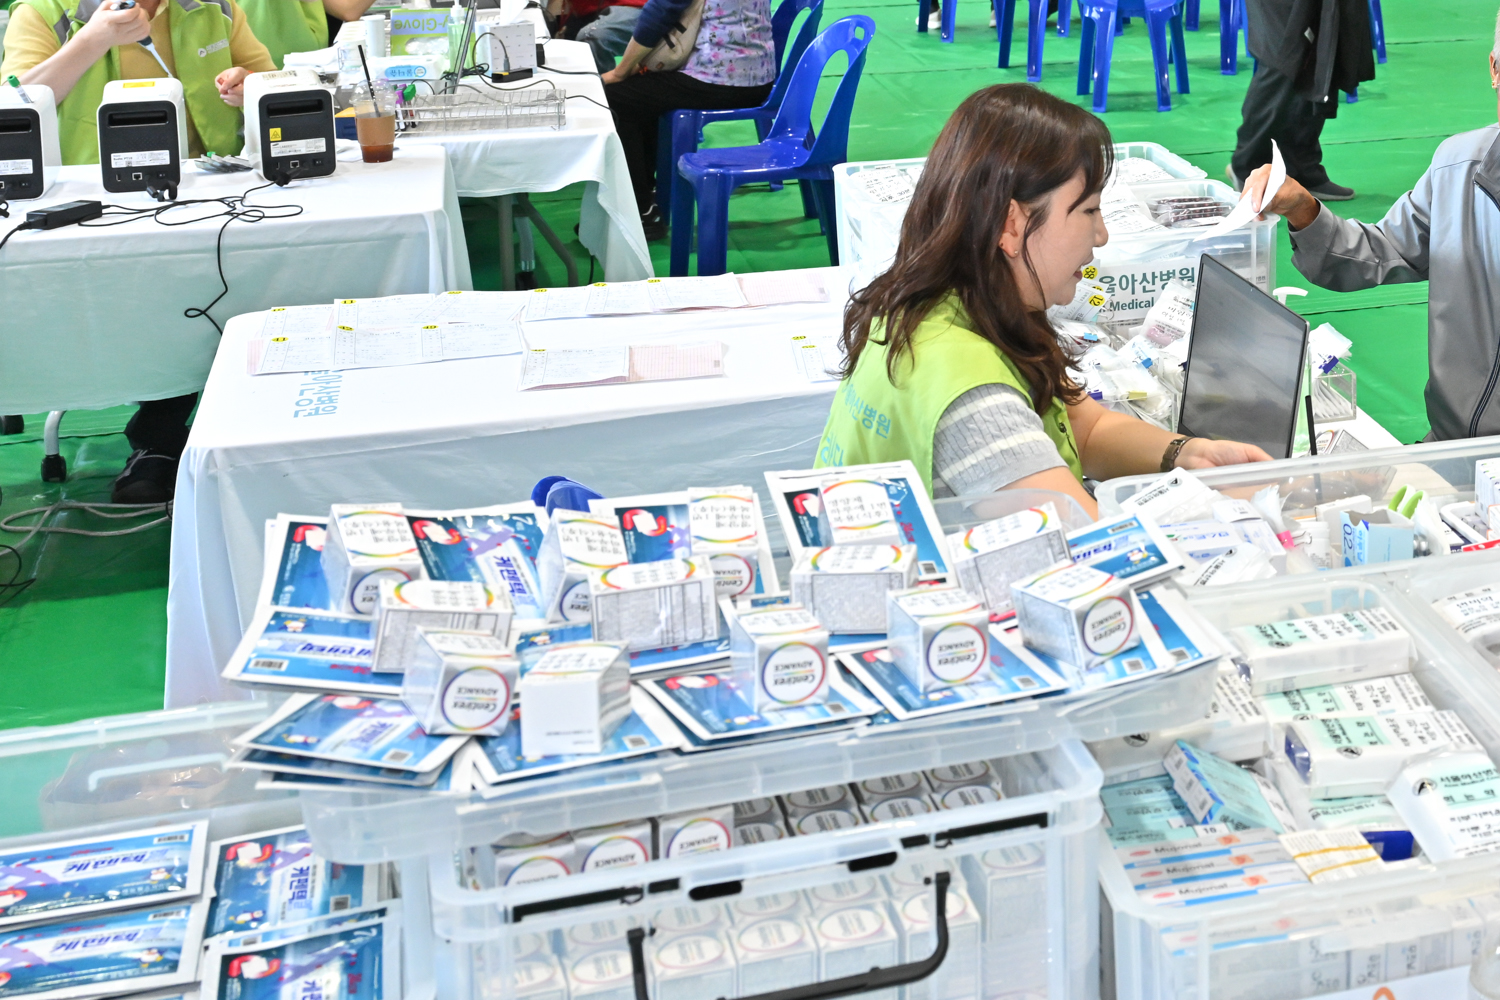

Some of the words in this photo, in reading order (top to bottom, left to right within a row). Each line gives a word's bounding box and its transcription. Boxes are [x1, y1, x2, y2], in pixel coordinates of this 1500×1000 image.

[1083, 267, 1096, 280] 38
[1090, 294, 1104, 306] 12
[1110, 297, 1155, 312] Medical
[1090, 610, 1122, 629] ADVANCE
[1092, 620, 1126, 642] Centirex
[937, 639, 976, 651] ADVANCE
[774, 660, 813, 672] ADVANCE
[937, 653, 977, 666] Centirex
[772, 674, 815, 687] Centirex
[456, 686, 499, 694] ADVANCE
[452, 701, 497, 712] Centirex
[1166, 862, 1215, 875] Mujonal
[1179, 883, 1228, 896] Mujonal
